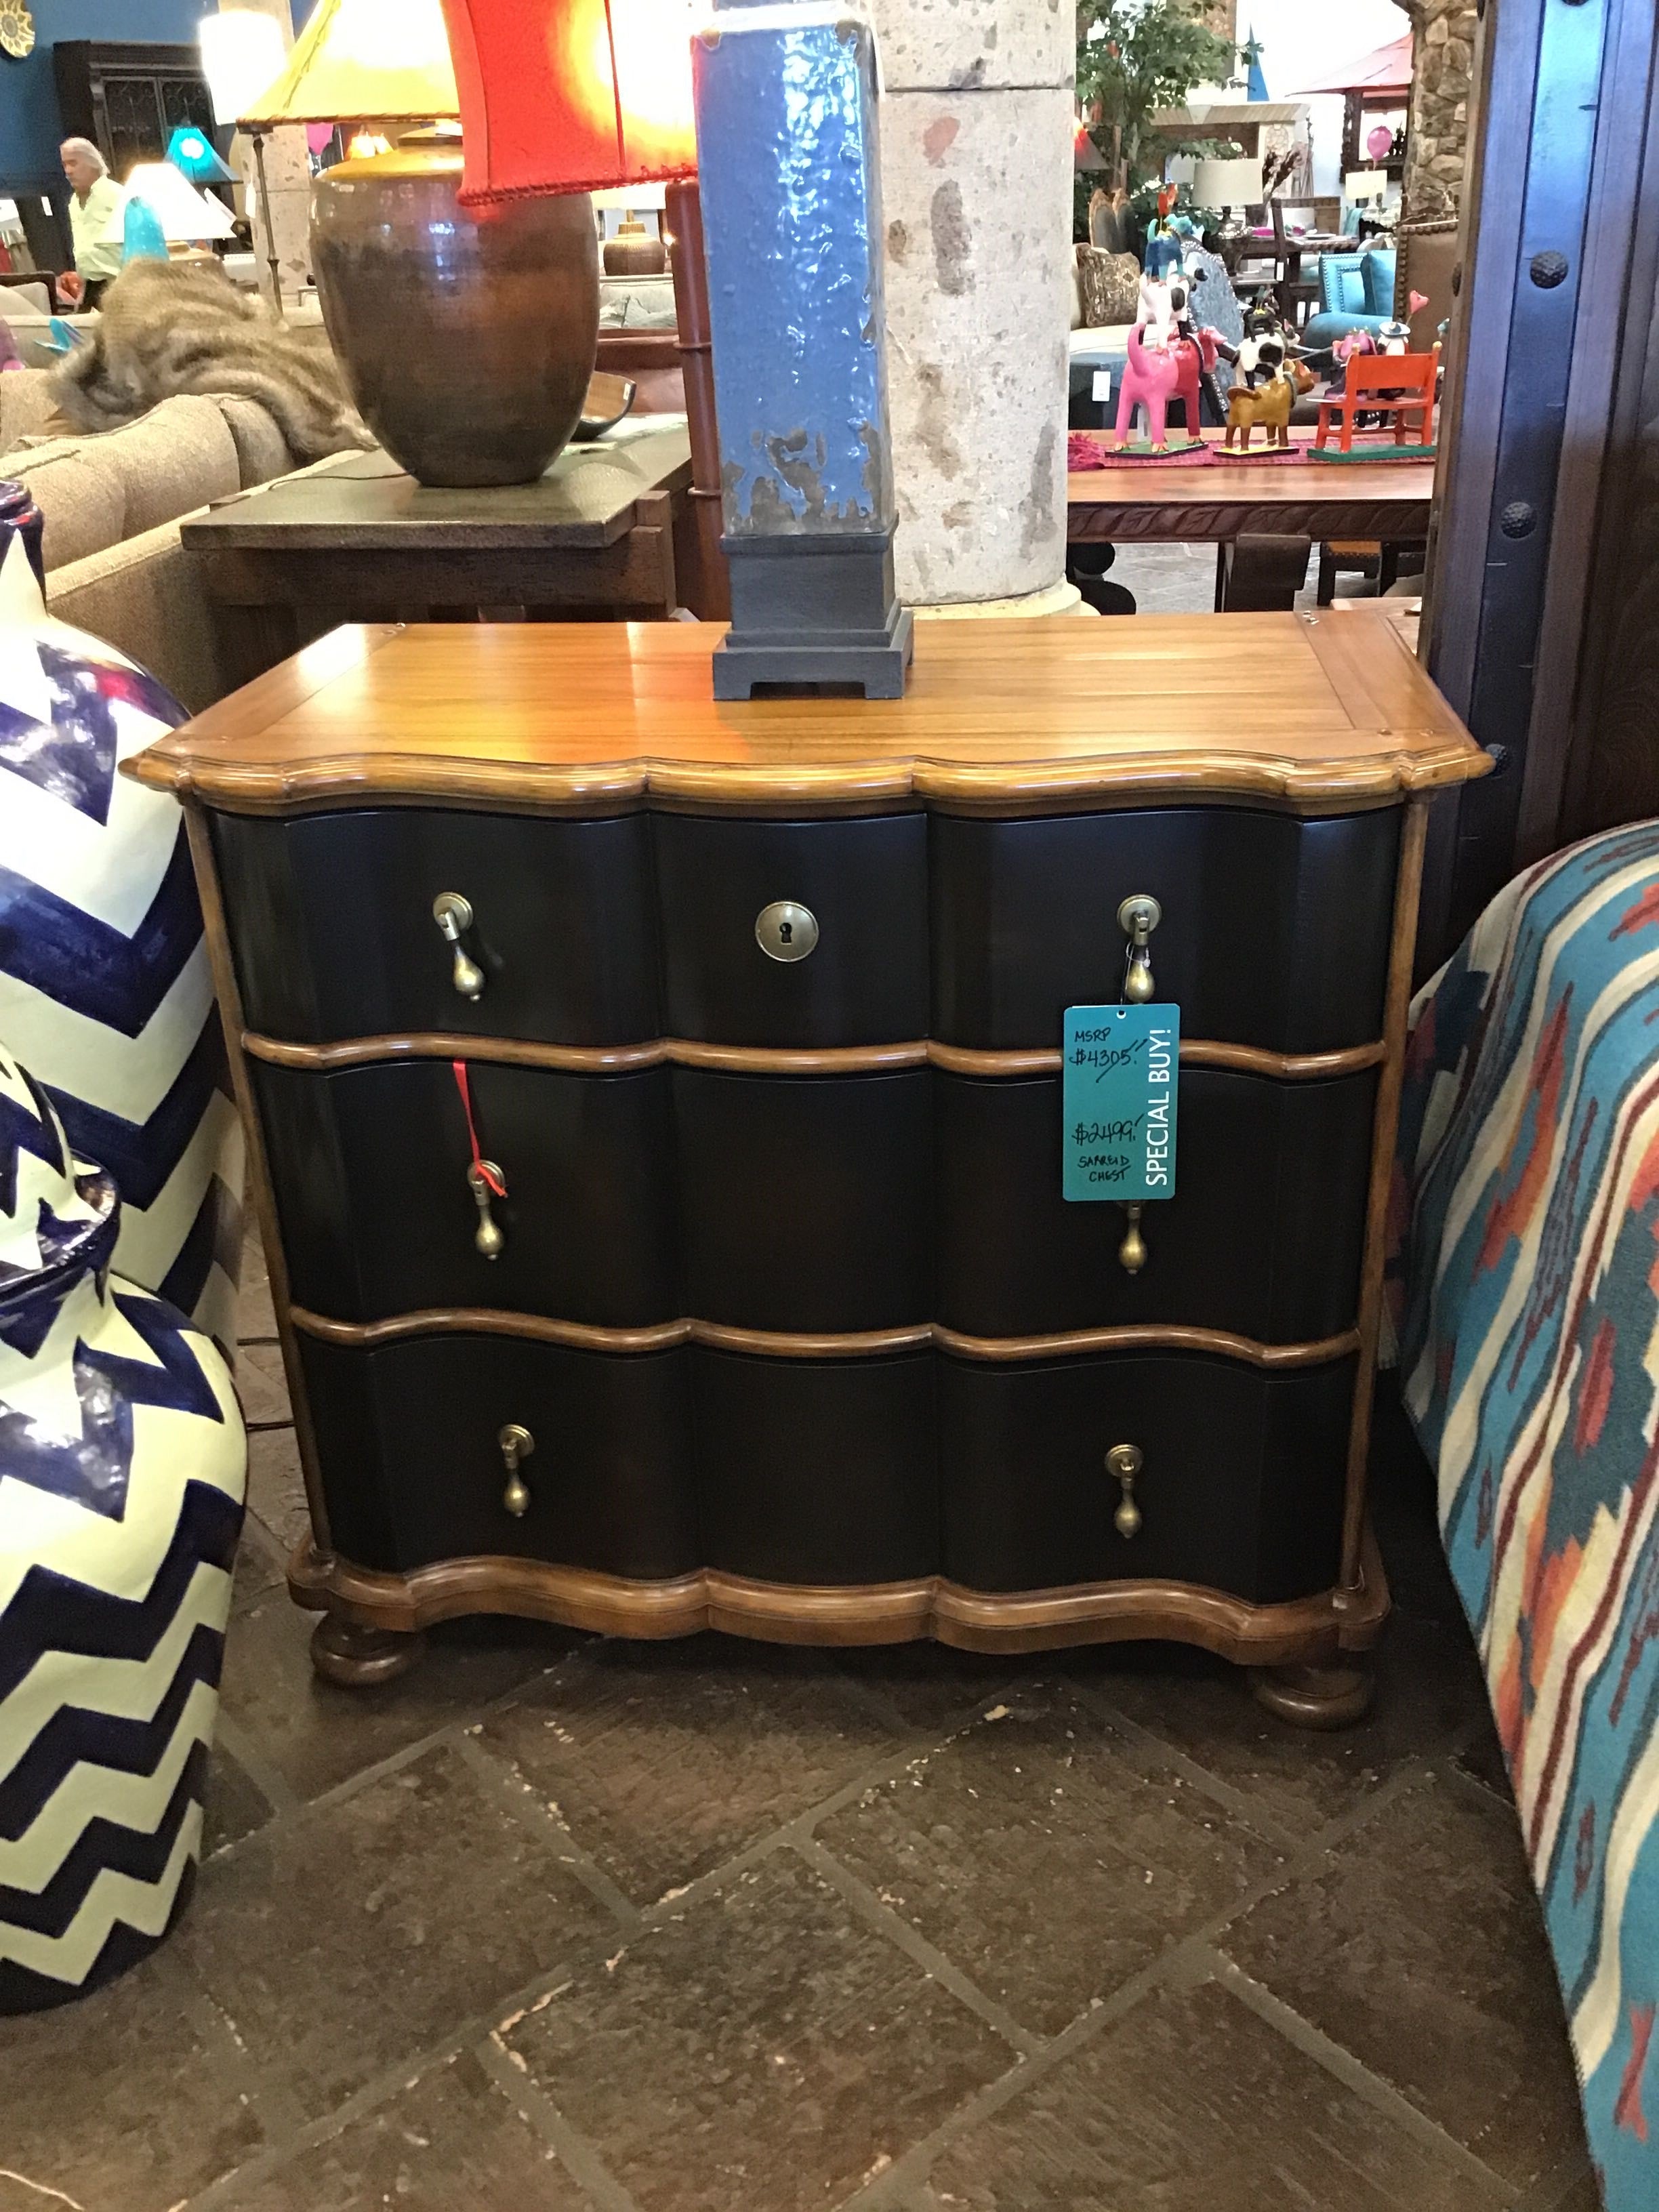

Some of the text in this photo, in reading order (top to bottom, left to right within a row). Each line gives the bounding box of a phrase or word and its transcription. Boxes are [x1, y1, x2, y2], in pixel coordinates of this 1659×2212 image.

[1074, 1027, 1111, 1042] MSRP
[1146, 1029, 1171, 1186] SPECIAL BUY!
[1089, 1166, 1131, 1182] CHEST
